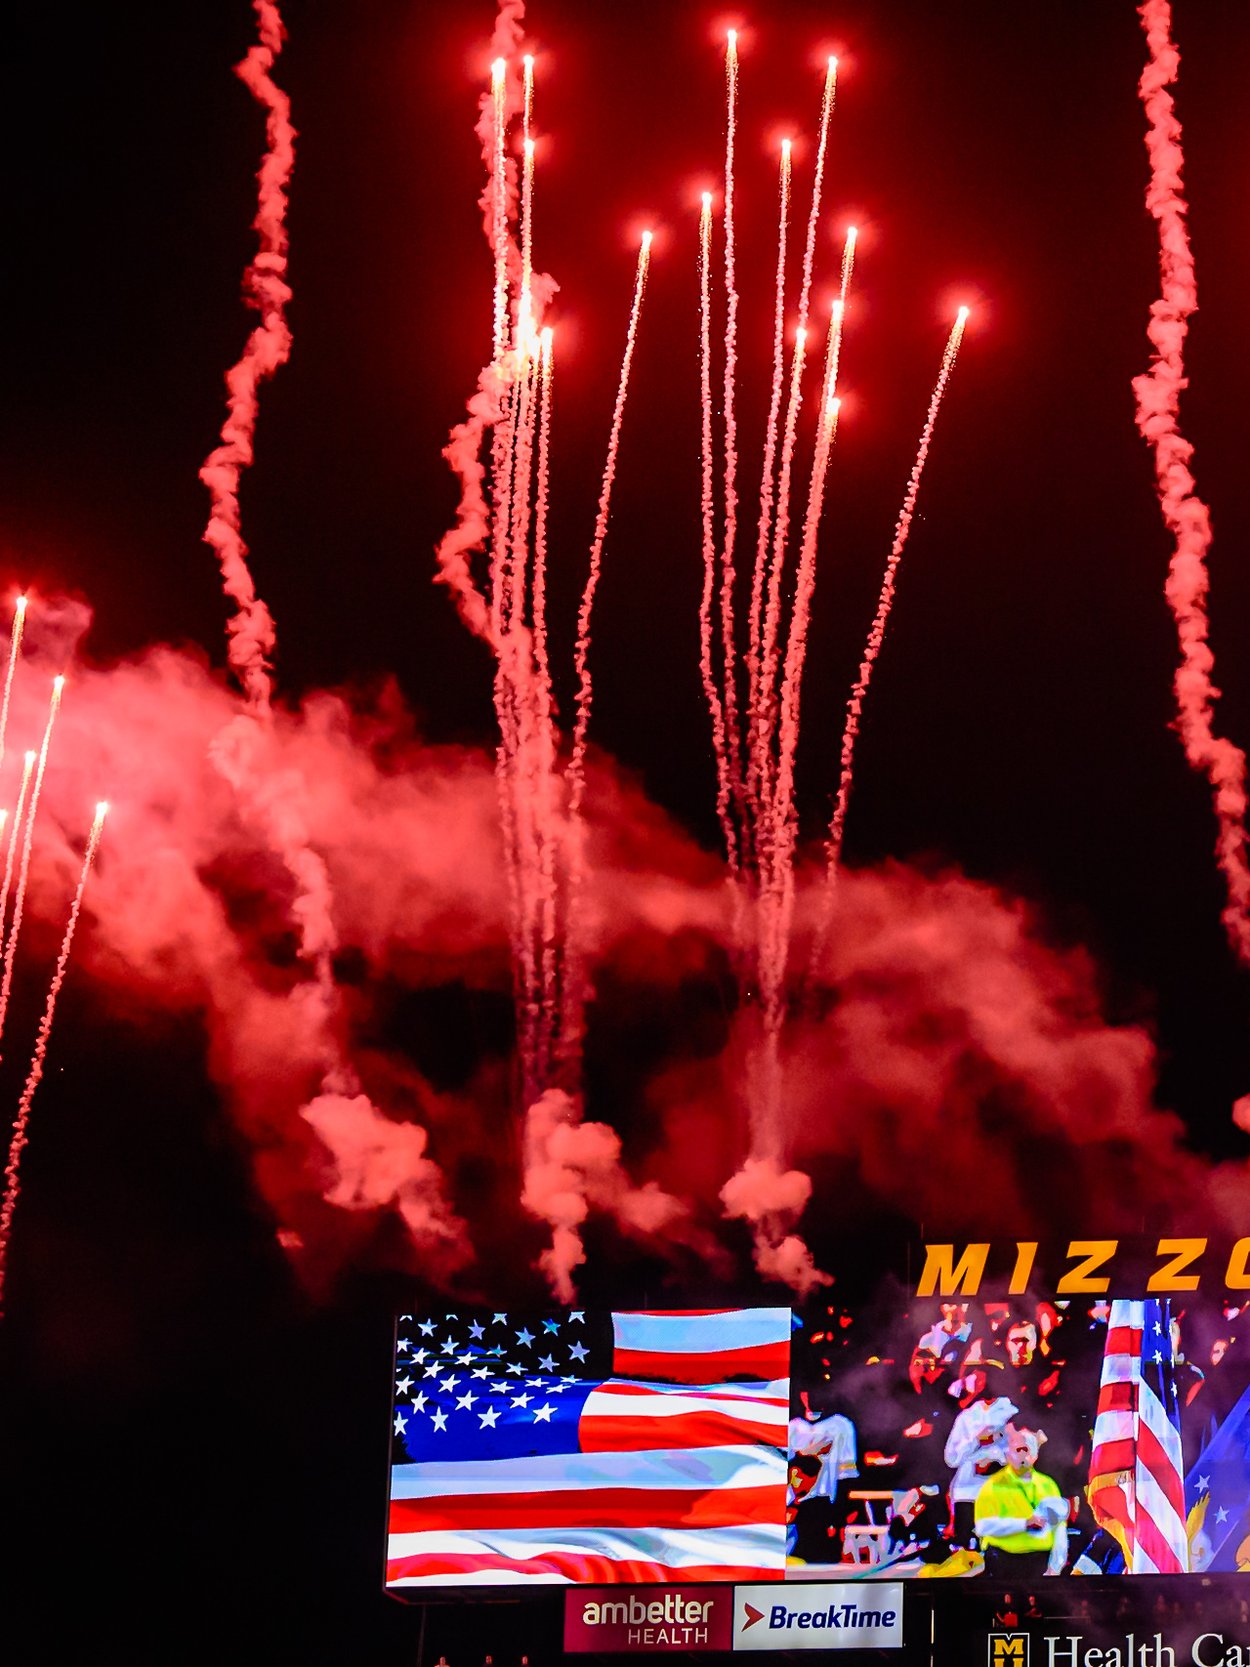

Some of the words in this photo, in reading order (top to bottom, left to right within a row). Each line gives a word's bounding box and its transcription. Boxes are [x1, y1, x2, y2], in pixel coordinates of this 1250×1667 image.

[583, 1594, 713, 1625] ambetter
[769, 1603, 896, 1629] BreakTime
[628, 1628, 708, 1645] HEALTH
[1043, 1633, 1176, 1667] Health
